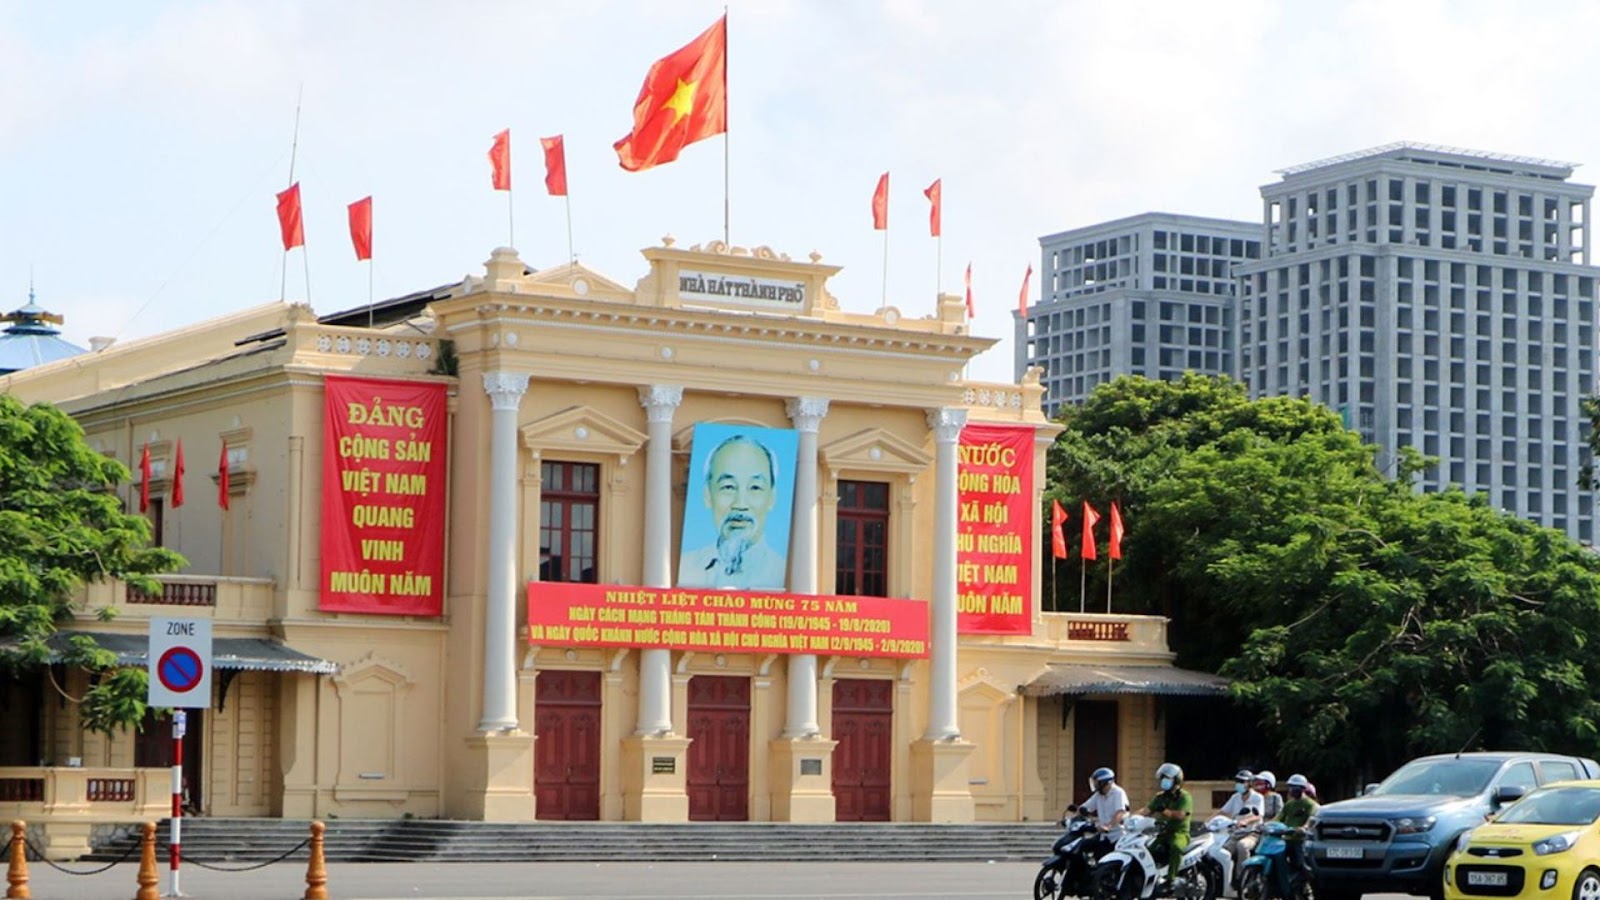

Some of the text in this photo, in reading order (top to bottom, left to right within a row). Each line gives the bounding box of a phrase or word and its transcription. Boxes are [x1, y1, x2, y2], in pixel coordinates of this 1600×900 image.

[680, 274, 706, 293] NHÀ
[707, 276, 733, 296] HÁT
[734, 279, 777, 300] THÀNH
[348, 397, 424, 428] ĐẢNG
[340, 432, 430, 462] CỘNG SẢN
[958, 442, 1016, 468] NƯỚC
[342, 468, 426, 496] VIỆT NAM
[958, 469, 1021, 495] ỘNG HÒA
[353, 505, 414, 528] QUANG
[960, 500, 1008, 528] XÃ HỘI
[362, 540, 404, 561] VINH
[957, 526, 1022, 554] HỦ NGHĨA
[330, 570, 431, 596] MUÔN NĂM
[958, 560, 1017, 586] IỆT NAM
[606, 591, 657, 606] NHIỆT
[662, 592, 698, 607] LIỆT
[703, 594, 745, 608] CHÀO
[801, 600, 820, 611] 75
[958, 590, 1022, 614] UÔN NĂM
[167, 622, 194, 636] ZONE
[569, 604, 596, 621] NGÀY
[598, 606, 625, 622] CÁCH
[628, 609, 657, 626] MẠNG
[660, 608, 692, 625] THÁNG
[694, 610, 715, 626] TÁM
[717, 611, 749, 627] THÀNH
[751, 612, 776, 629] CÔNG
[531, 624, 544, 640] VÀ
[546, 624, 570, 640] NGÀY
[662, 628, 687, 646] CỘNG
[790, 634, 808, 651] VIỆT
[810, 636, 829, 650] NAM
